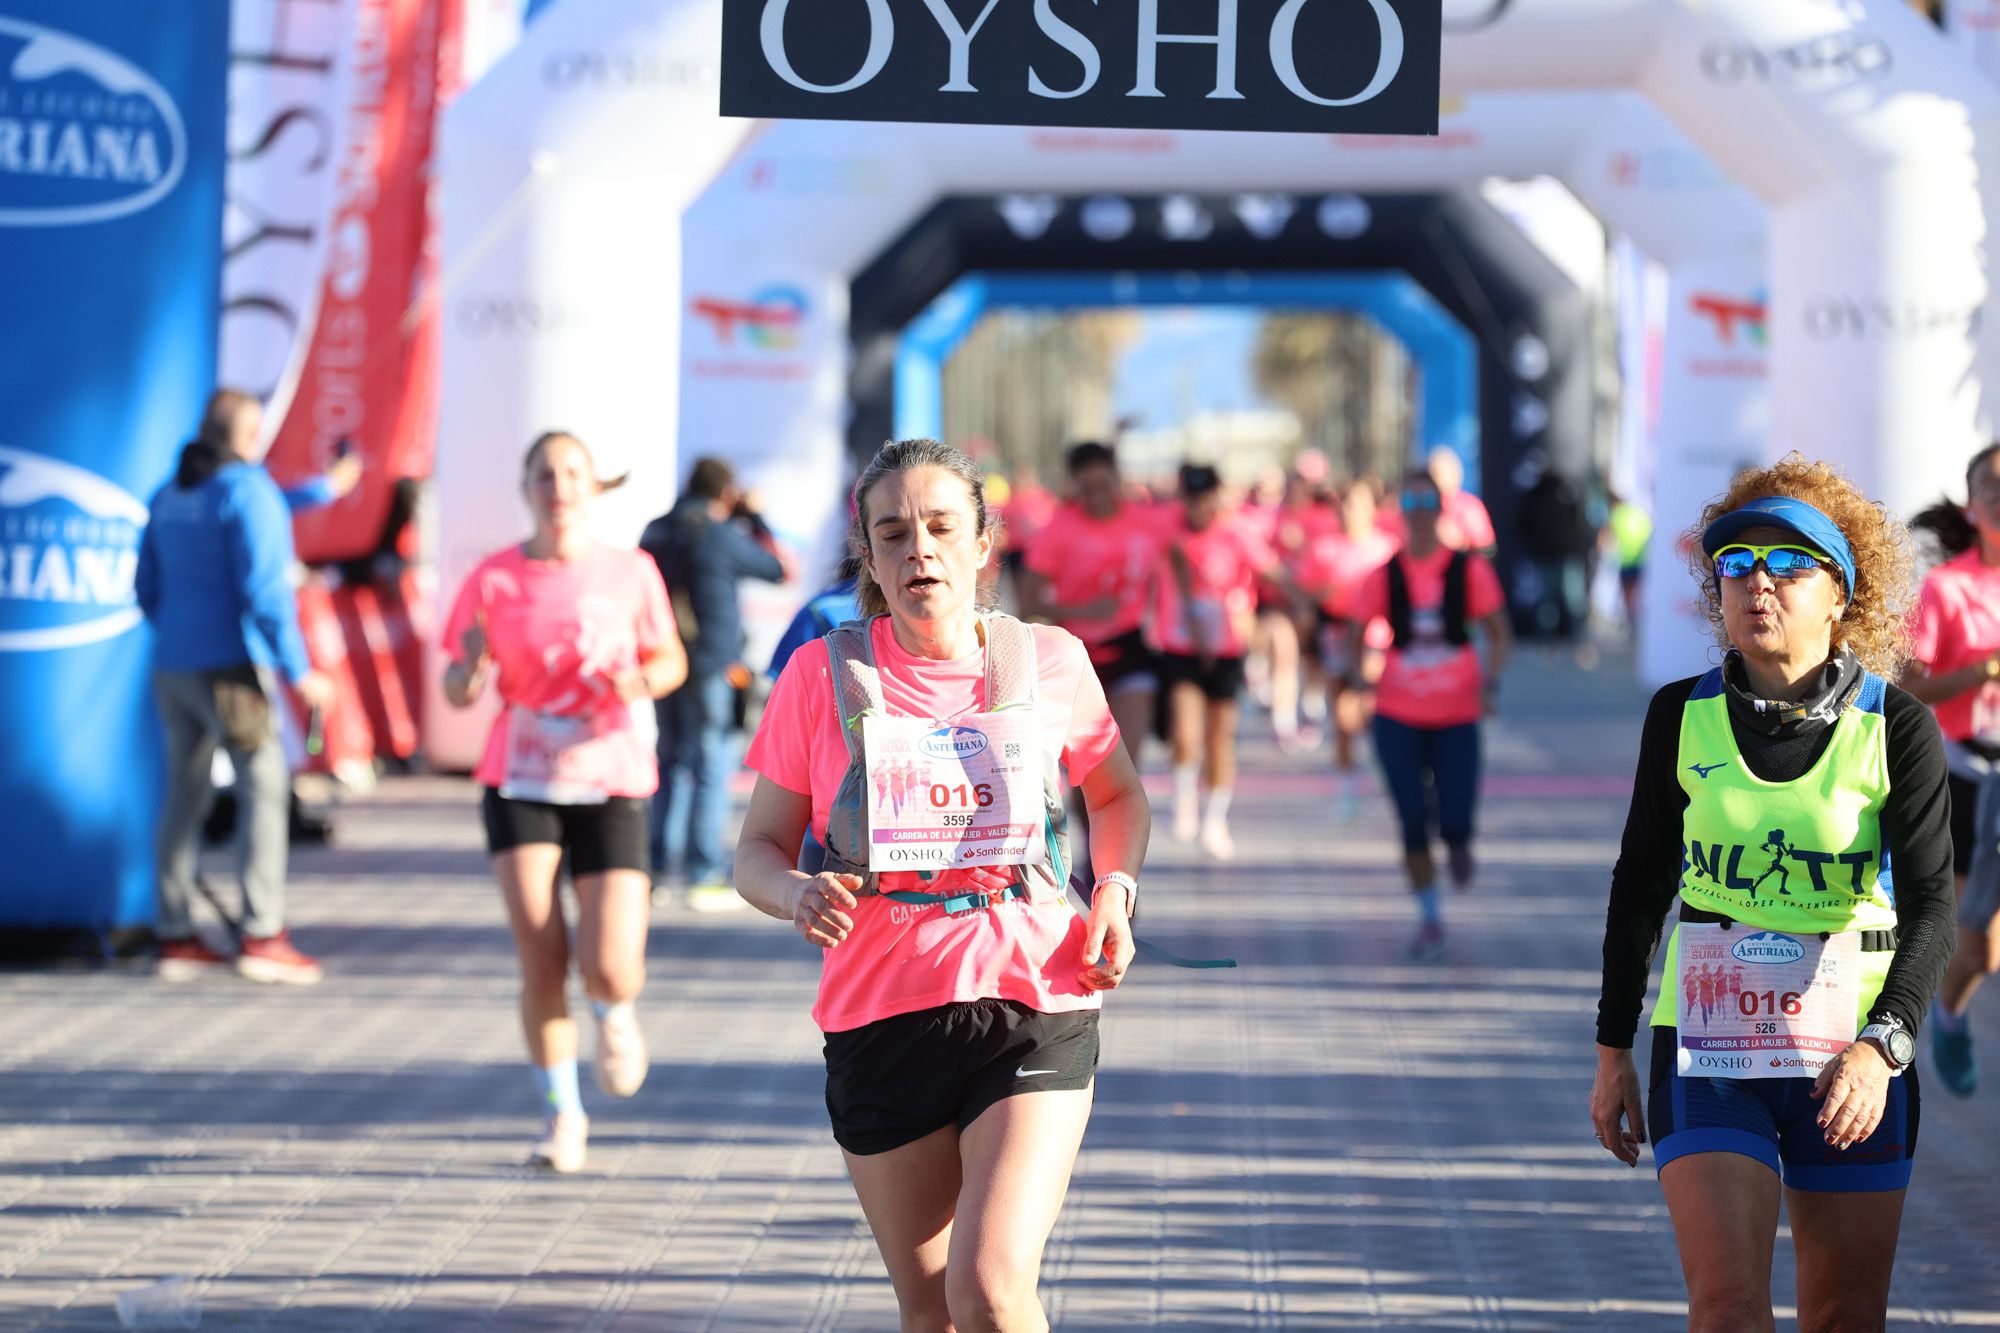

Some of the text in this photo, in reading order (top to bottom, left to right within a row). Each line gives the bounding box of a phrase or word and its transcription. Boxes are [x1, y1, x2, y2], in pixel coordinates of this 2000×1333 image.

[759, 0, 1404, 107] OYSHO
[926, 739, 983, 751] ASTURIANA
[930, 783, 993, 807] 016
[943, 815, 973, 826] 3595
[892, 827, 1023, 840] CARRERA DE LA MUJER VALENCIA
[889, 846, 1026, 861] OYSHO Santander
[1691, 950, 1725, 960] SUMA
[1736, 943, 1800, 958] ASTURIANA
[1739, 990, 1802, 1016] 016
[1755, 1022, 1776, 1034] 526
[1701, 1038, 1832, 1050] CARRERA DE LA MUJER VALENCIA
[1699, 1056, 1825, 1069] OYSHO Santand
